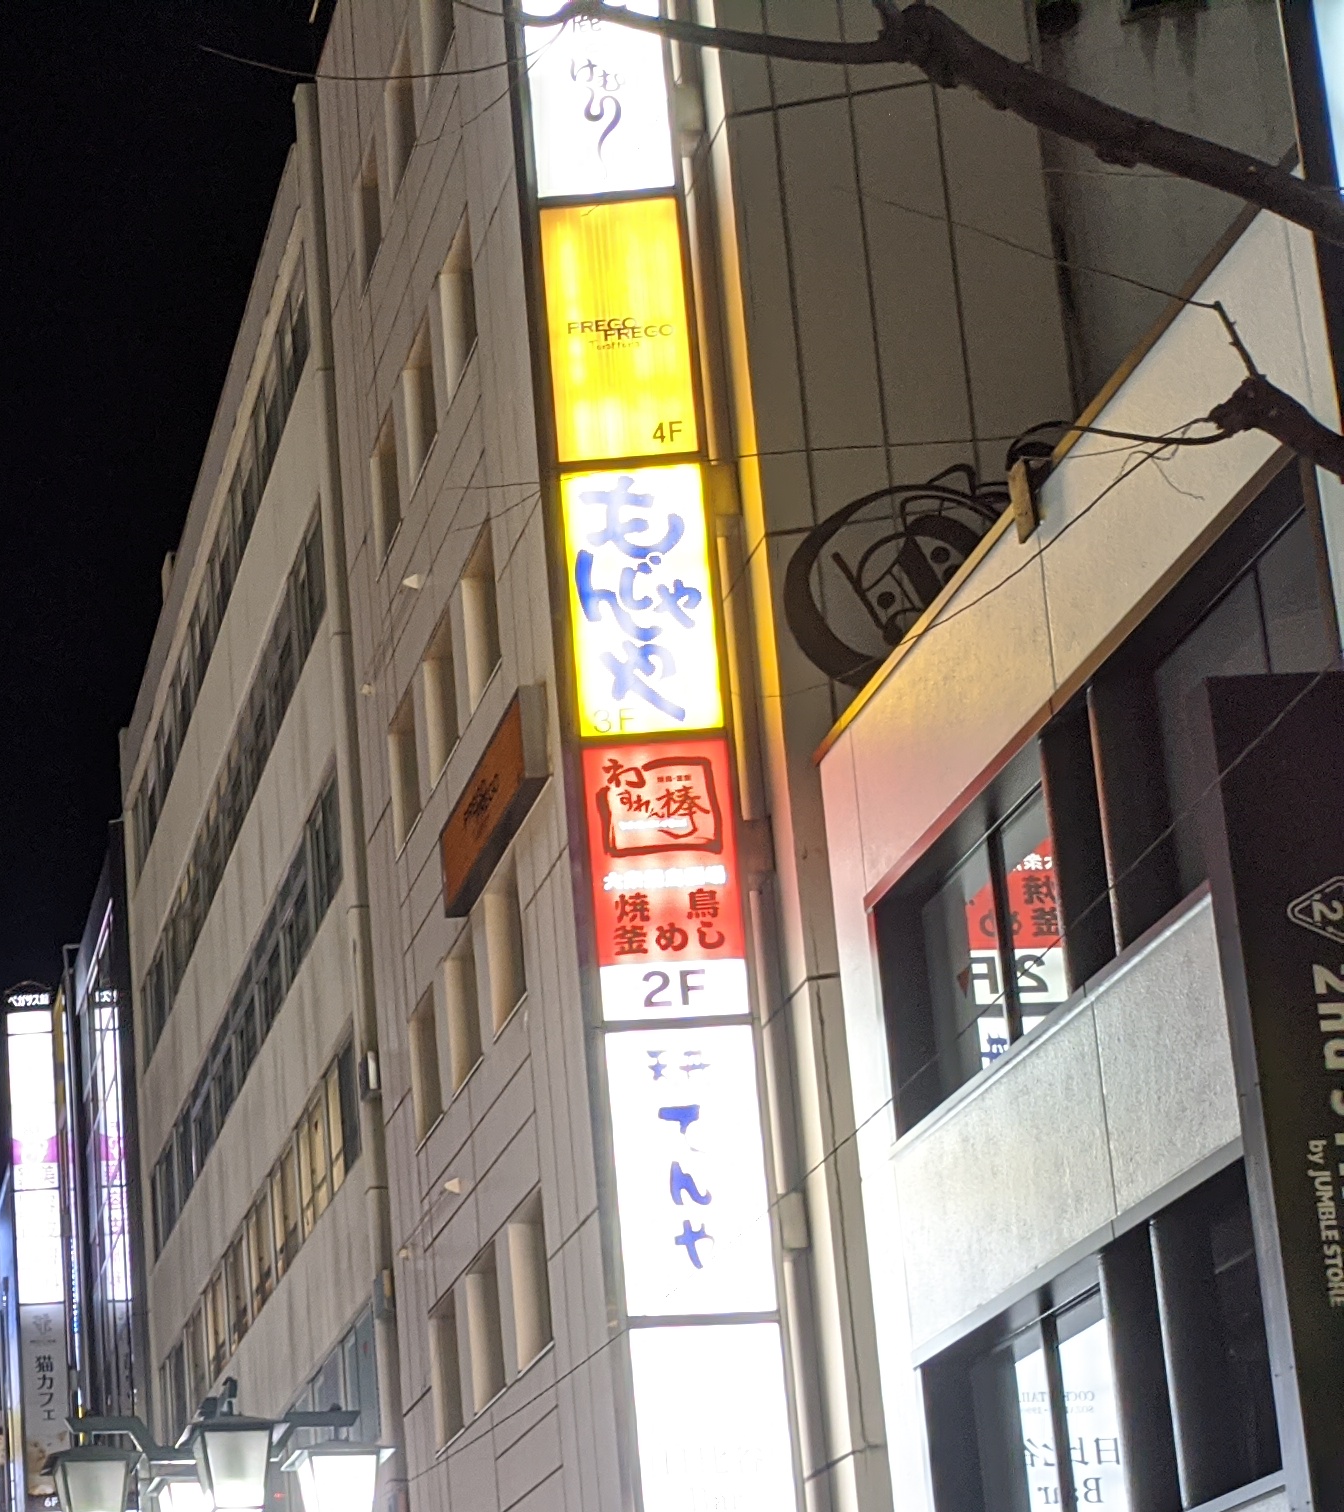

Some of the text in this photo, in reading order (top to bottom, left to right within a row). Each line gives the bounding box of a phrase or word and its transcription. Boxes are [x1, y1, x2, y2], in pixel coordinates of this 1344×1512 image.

[603, 324, 675, 341] PREGO
[652, 420, 684, 445] 4F
[592, 706, 637, 734] 3F
[613, 921, 726, 956] 釜めし
[642, 968, 707, 1009] 2F
[1308, 1138, 1327, 1176] by
[658, 1104, 714, 1269] てんや
[1313, 1169, 1339, 1243] JUMBLE
[35, 1354, 57, 1422] 猫カフェ
